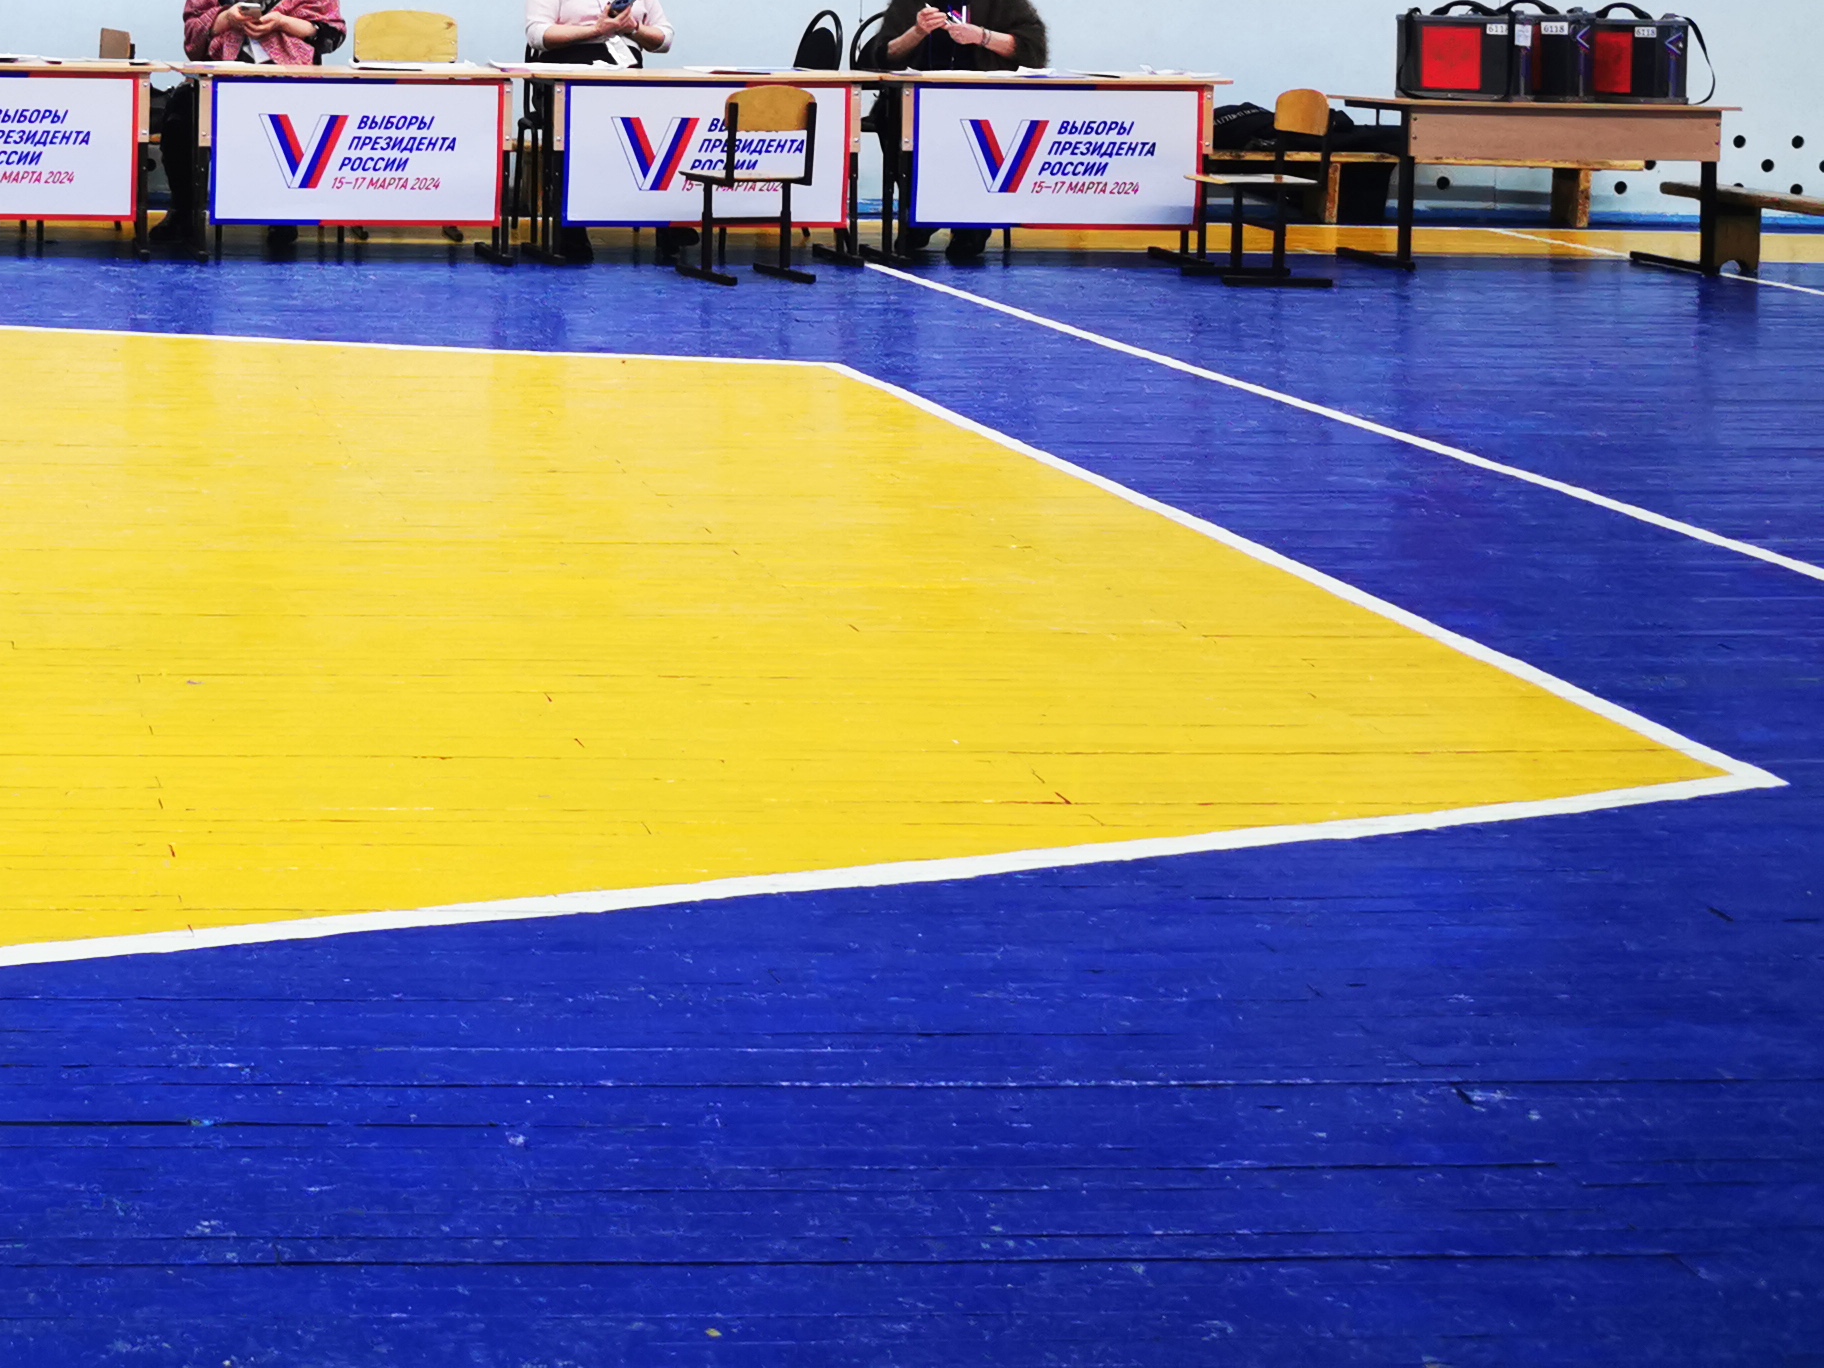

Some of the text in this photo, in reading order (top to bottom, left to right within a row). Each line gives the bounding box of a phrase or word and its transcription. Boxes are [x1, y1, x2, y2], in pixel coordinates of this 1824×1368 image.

[357, 115, 435, 131] ВЫБОРЫ
[1057, 120, 1135, 136] ВЫБОРЫ
[348, 136, 457, 153] ПРЕЗИДЕНТА
[1048, 141, 1157, 158] ПРЕЗИДЕНТА
[338, 157, 409, 172] РОССИИ
[690, 159, 758, 170] РОСИИ
[1038, 161, 1109, 177] РОССИИ
[0, 171, 42, 184] МАРТА
[43, 171, 74, 184] 2024
[366, 177, 409, 190] МАРТА
[410, 177, 441, 191] 2024
[758, 181, 783, 192] 202
[1066, 181, 1107, 194] МАРТА
[1109, 181, 1140, 195] 2024
